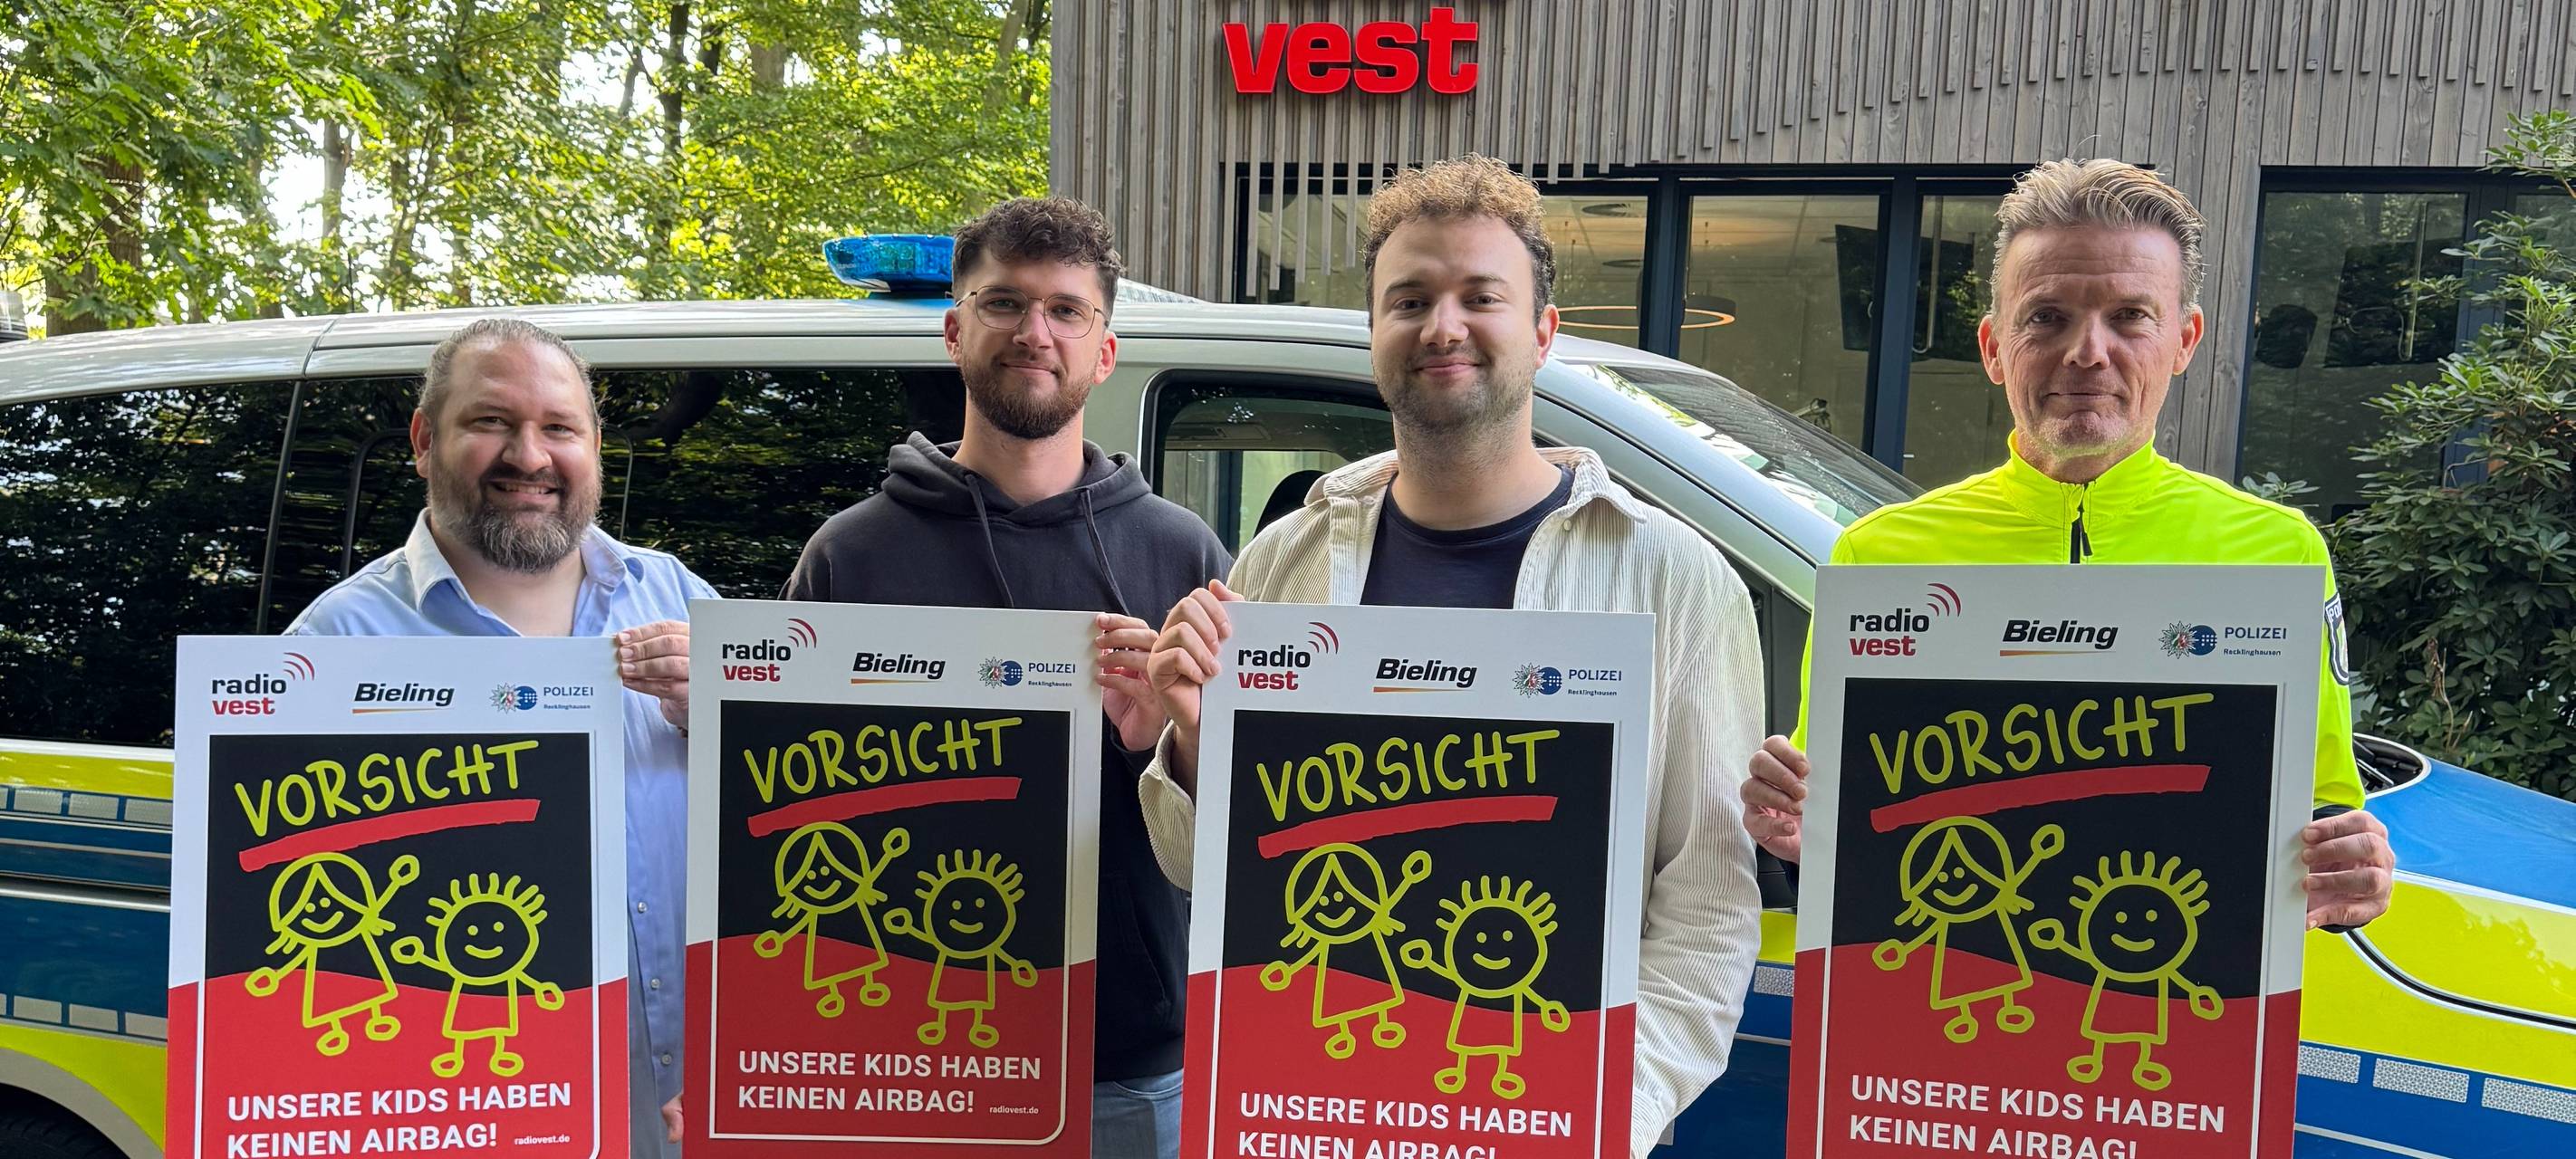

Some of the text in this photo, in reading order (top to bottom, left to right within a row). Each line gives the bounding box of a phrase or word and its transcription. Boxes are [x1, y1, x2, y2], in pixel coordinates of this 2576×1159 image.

[1222, 5, 1479, 95] vest
[1850, 608, 1930, 633] radio
[2224, 627, 2287, 639] POLIZEI
[1850, 635, 1917, 656] vest
[2002, 619, 2119, 650] Bieling
[722, 638, 792, 661] radio
[1237, 644, 1311, 668] radio
[2223, 647, 2282, 656] Recklinghausen
[723, 664, 781, 683] vest
[852, 652, 947, 680] Bieling
[1028, 662, 1076, 674] POLIZEI
[1375, 657, 1477, 688] Bieling
[1568, 669, 1622, 681] POLIZEI
[212, 674, 287, 694] radio
[543, 686, 594, 696] POLIZEI
[1237, 670, 1299, 691] vest
[212, 696, 275, 715] vest
[353, 683, 455, 706] Bieling
[1870, 693, 2214, 794] VORSICHT
[743, 716, 1023, 804] VORSICHT
[1255, 729, 1560, 821] VORSICHT
[234, 740, 539, 837] VORSICHT
[738, 1050, 1041, 1080] UNSERE KIDS HABEN
[227, 1082, 572, 1121] UNSERE KIDS HABEN
[738, 1086, 975, 1113] KEINEN AIRBAG!
[989, 1105, 1039, 1115] radiovest.de
[1851, 1074, 2225, 1133] UNSERE KIDS HABEN
[1240, 1092, 1572, 1137] UNSERE KIDS HABEN
[226, 1122, 498, 1159] KEINEN AIRBAG!
[514, 1134, 571, 1145] radiovest.de
[1238, 1132, 1354, 1159] KEINEN
[1850, 1115, 2138, 1159] KEINEN AIRBAG!
